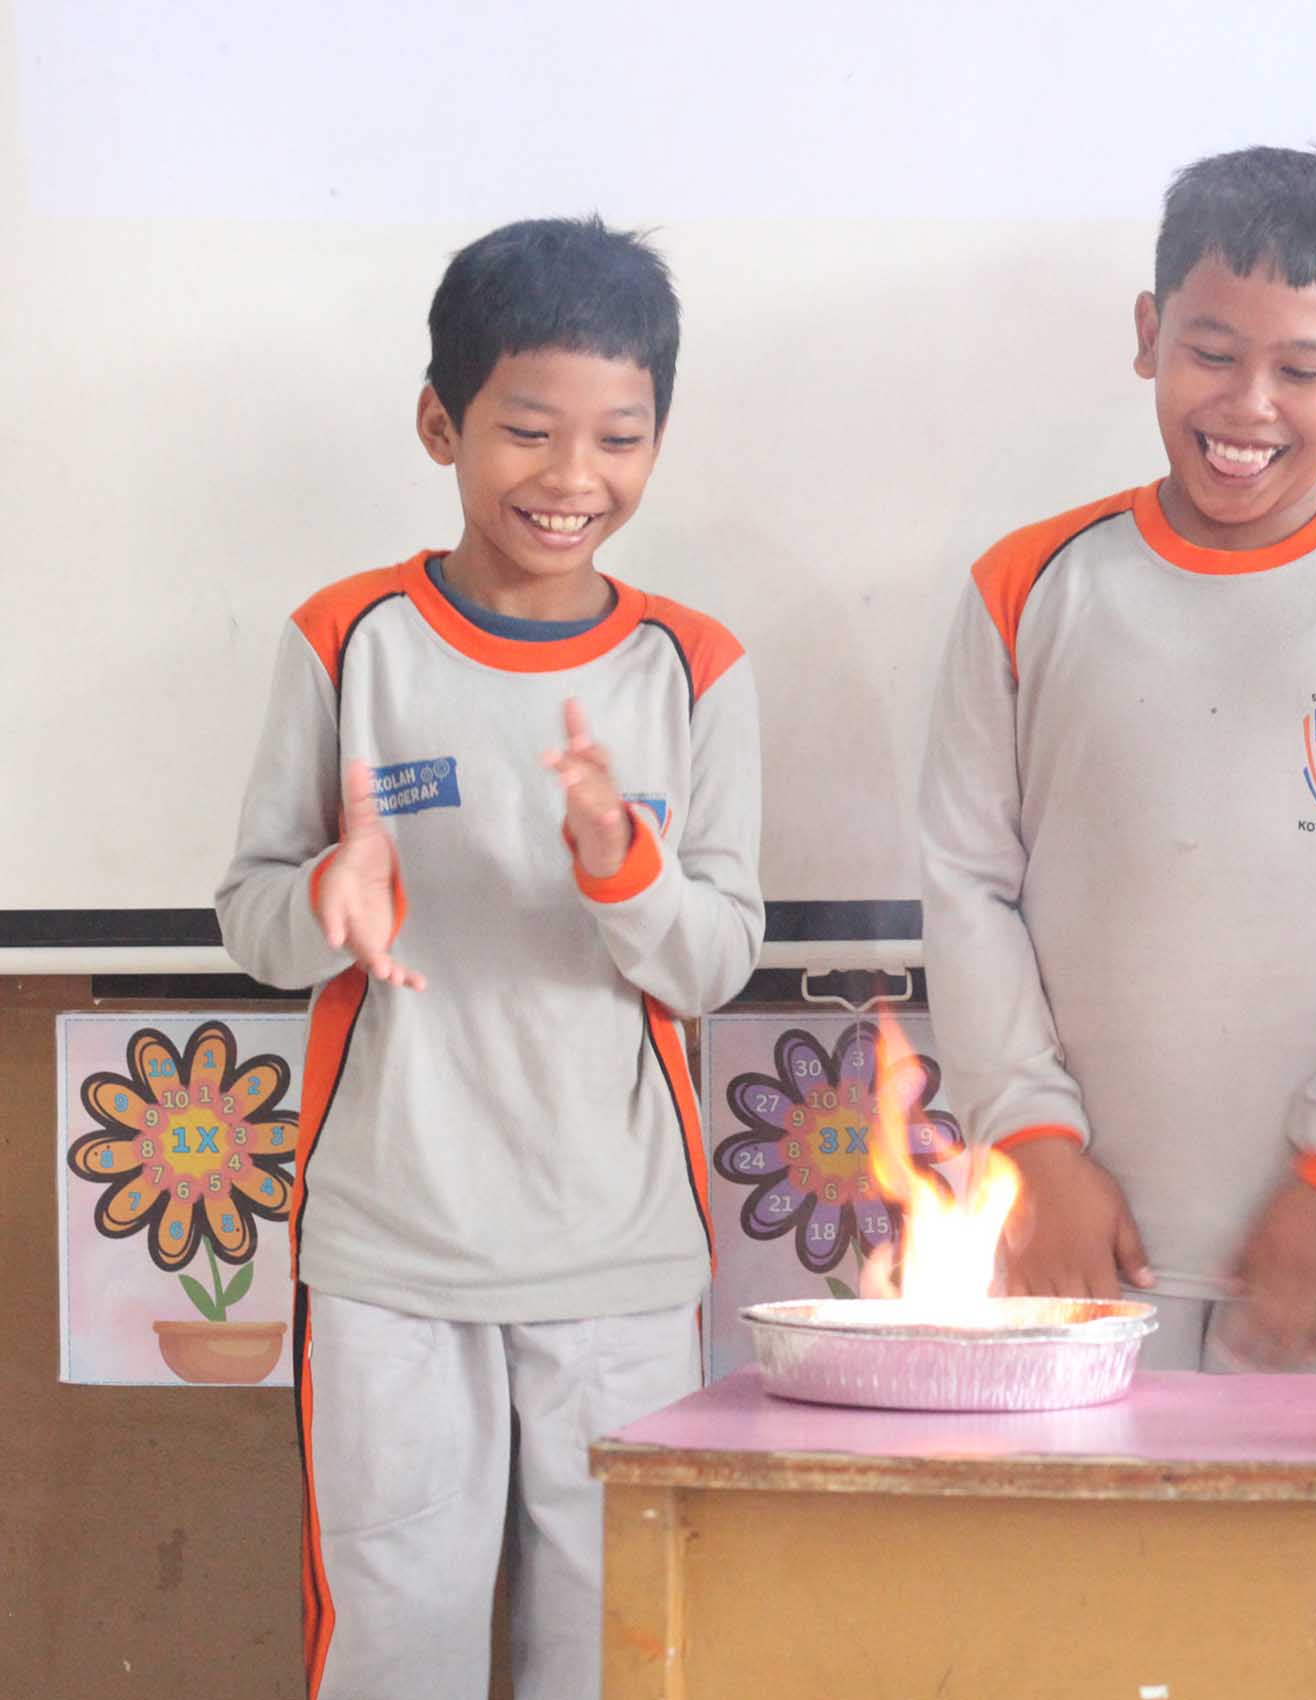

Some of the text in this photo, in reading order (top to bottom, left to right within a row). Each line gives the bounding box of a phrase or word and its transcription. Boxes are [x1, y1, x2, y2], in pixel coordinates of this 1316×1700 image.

[368, 768, 416, 793] EKOLAH
[375, 781, 440, 813] ENGGERAK
[203, 1050, 217, 1069] 1
[796, 1059, 822, 1076] 30
[852, 1051, 865, 1067] 3
[149, 1059, 176, 1078] 10
[200, 1086, 211, 1103] 1
[247, 1077, 262, 1095] 2
[849, 1087, 859, 1103] 1
[114, 1094, 128, 1112] 9
[163, 1090, 189, 1109] 10
[222, 1097, 236, 1114] 2
[755, 1095, 780, 1113] 27
[810, 1092, 837, 1109] 10
[145, 1109, 160, 1127] 9
[792, 1110, 805, 1127] 9
[235, 1127, 249, 1145] 3
[271, 1127, 285, 1145] 3
[920, 1128, 934, 1145] 9
[141, 1140, 155, 1158] 8
[788, 1142, 801, 1158] 8
[101, 1151, 114, 1168] 8
[228, 1154, 242, 1171] 4
[738, 1152, 766, 1169] 24
[151, 1167, 164, 1184] 7
[209, 1175, 222, 1192] 5
[799, 1168, 811, 1184] 7
[176, 1181, 190, 1199] 6
[260, 1178, 275, 1196] 4
[825, 1184, 838, 1200] 6
[858, 1177, 870, 1193] 5
[128, 1193, 142, 1211] 7
[768, 1195, 794, 1213] 21
[169, 1221, 184, 1240] 6
[221, 1215, 234, 1233] 5
[810, 1223, 836, 1241] 18
[864, 1216, 889, 1234] 15
